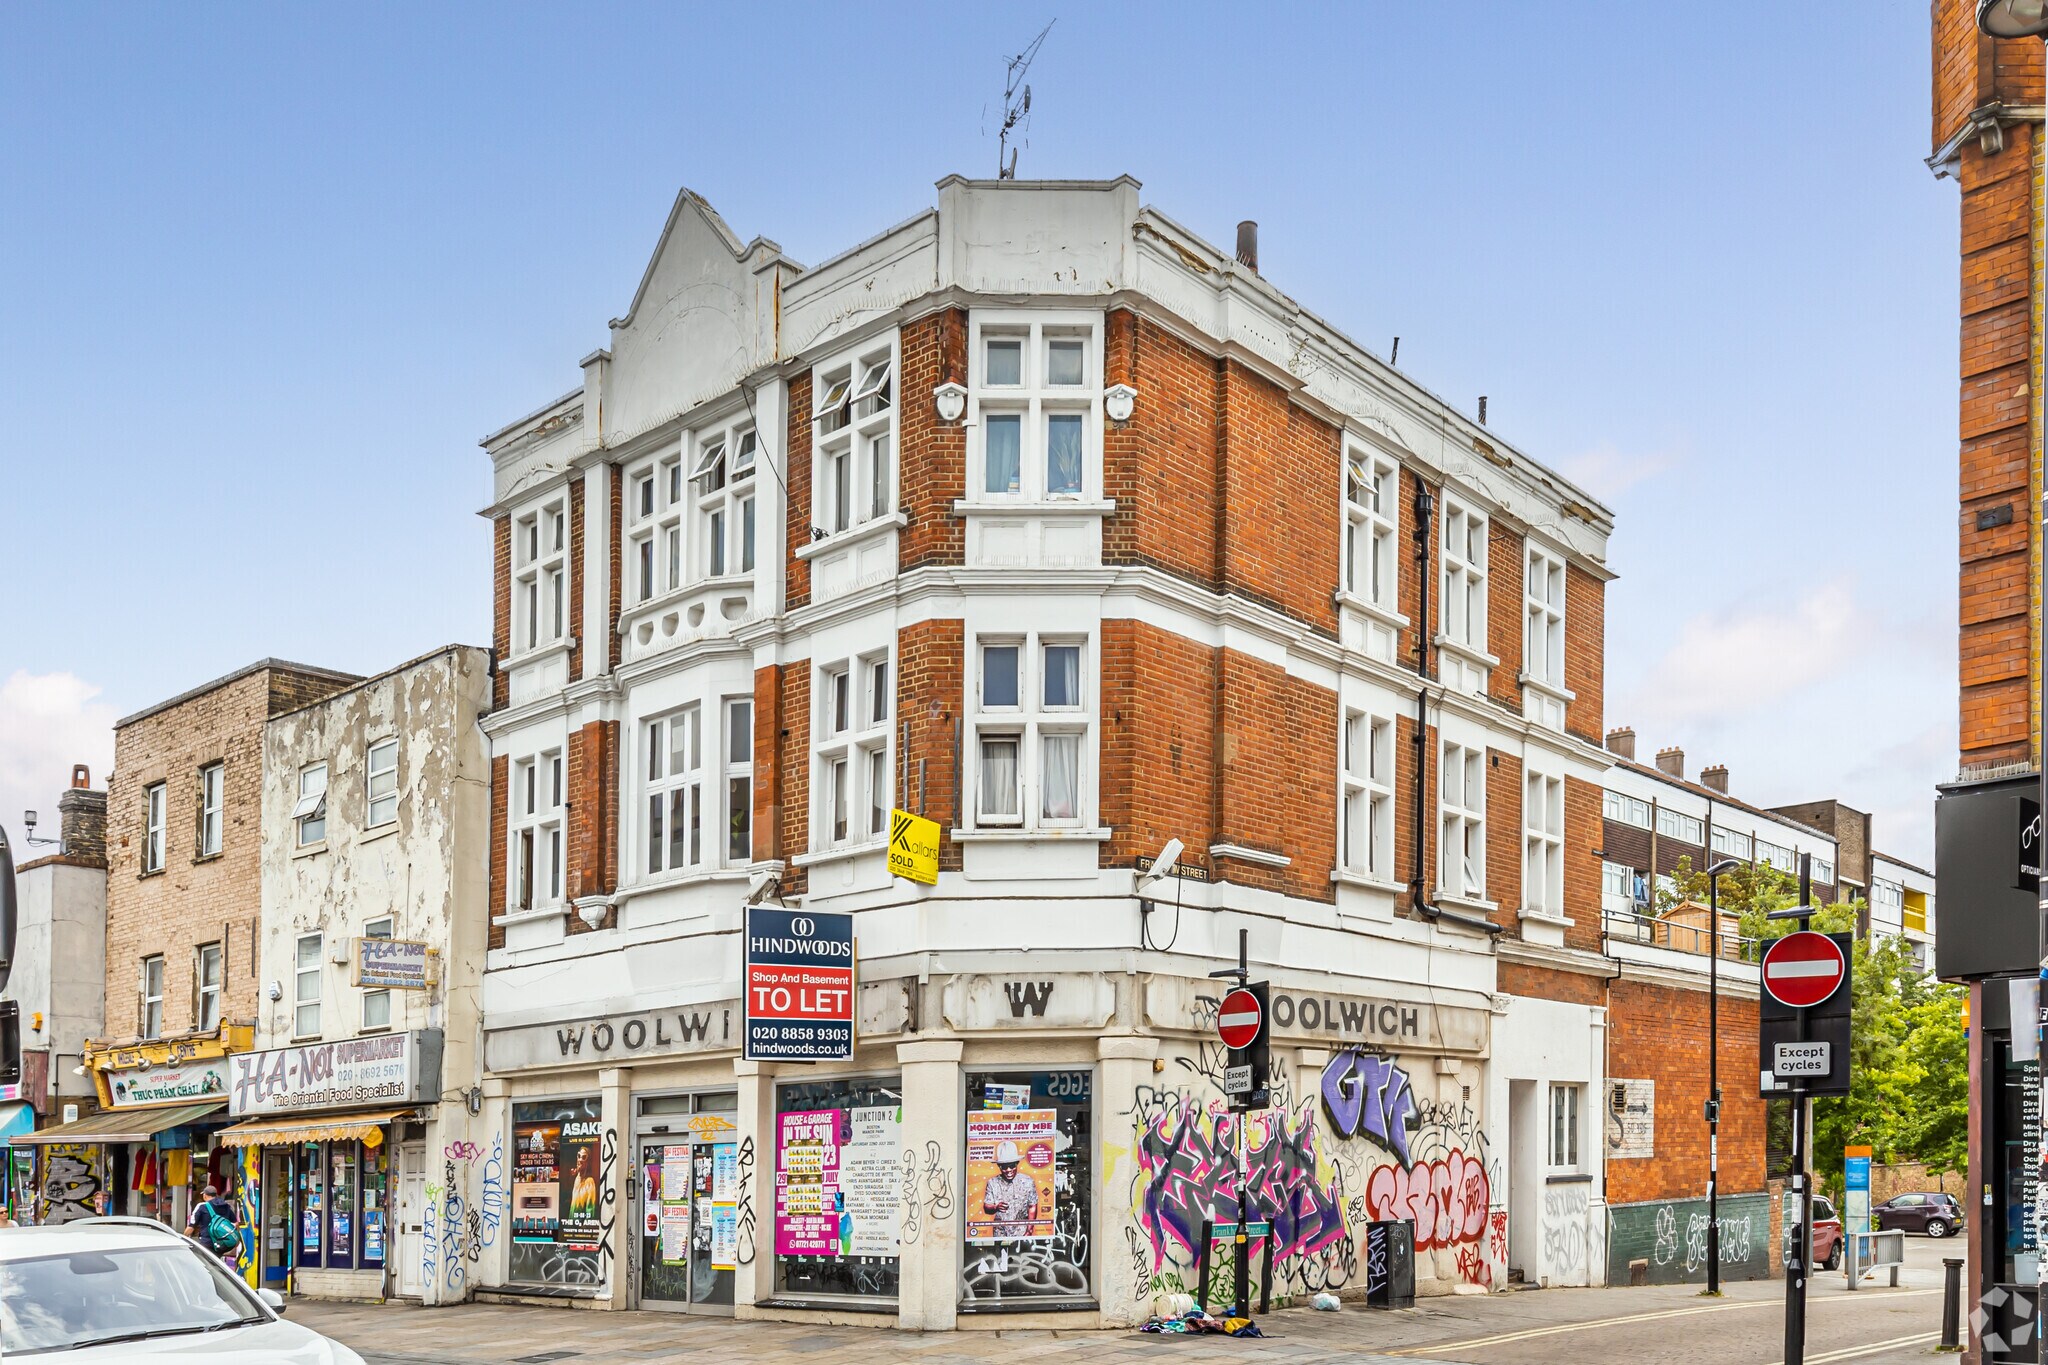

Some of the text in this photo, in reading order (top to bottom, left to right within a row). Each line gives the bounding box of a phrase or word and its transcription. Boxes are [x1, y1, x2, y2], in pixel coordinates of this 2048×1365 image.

[890, 853, 914, 868] SOLD
[1181, 865, 1208, 880] STREET
[2020, 864, 2040, 876] OPTICIAN
[752, 937, 850, 957] HINDWOODS
[752, 972, 849, 985] Shop And Basement
[753, 987, 848, 1013] TO LET
[1004, 982, 1054, 1018] W
[1272, 995, 1418, 1037] OOLWICH
[556, 1009, 730, 1056] WOOLWI
[752, 1027, 849, 1041] 020 8858 9303
[337, 1036, 405, 1065] SUPERMARKET
[752, 1043, 847, 1055] hindwoods.co.uk
[1779, 1046, 1825, 1059] Except
[1781, 1060, 1822, 1072] cycles
[235, 1045, 334, 1112] HA-NOI
[337, 1069, 353, 1082] 020
[360, 1066, 381, 1080] 8692
[1227, 1070, 1249, 1079] Except
[1228, 1080, 1248, 1090] cycles
[272, 1081, 405, 1107] The Oriental Food Specialist
[783, 1115, 804, 1126] HOUSE
[808, 1113, 833, 1125] GARAGE
[855, 1110, 893, 1122] JUNCTION 2
[1033, 1122, 1052, 1130] MBE
[672, 1146, 688, 1156] FESTIVA
[672, 1207, 688, 1216] FESTIVA
[1213, 1225, 1235, 1237] Frankh
